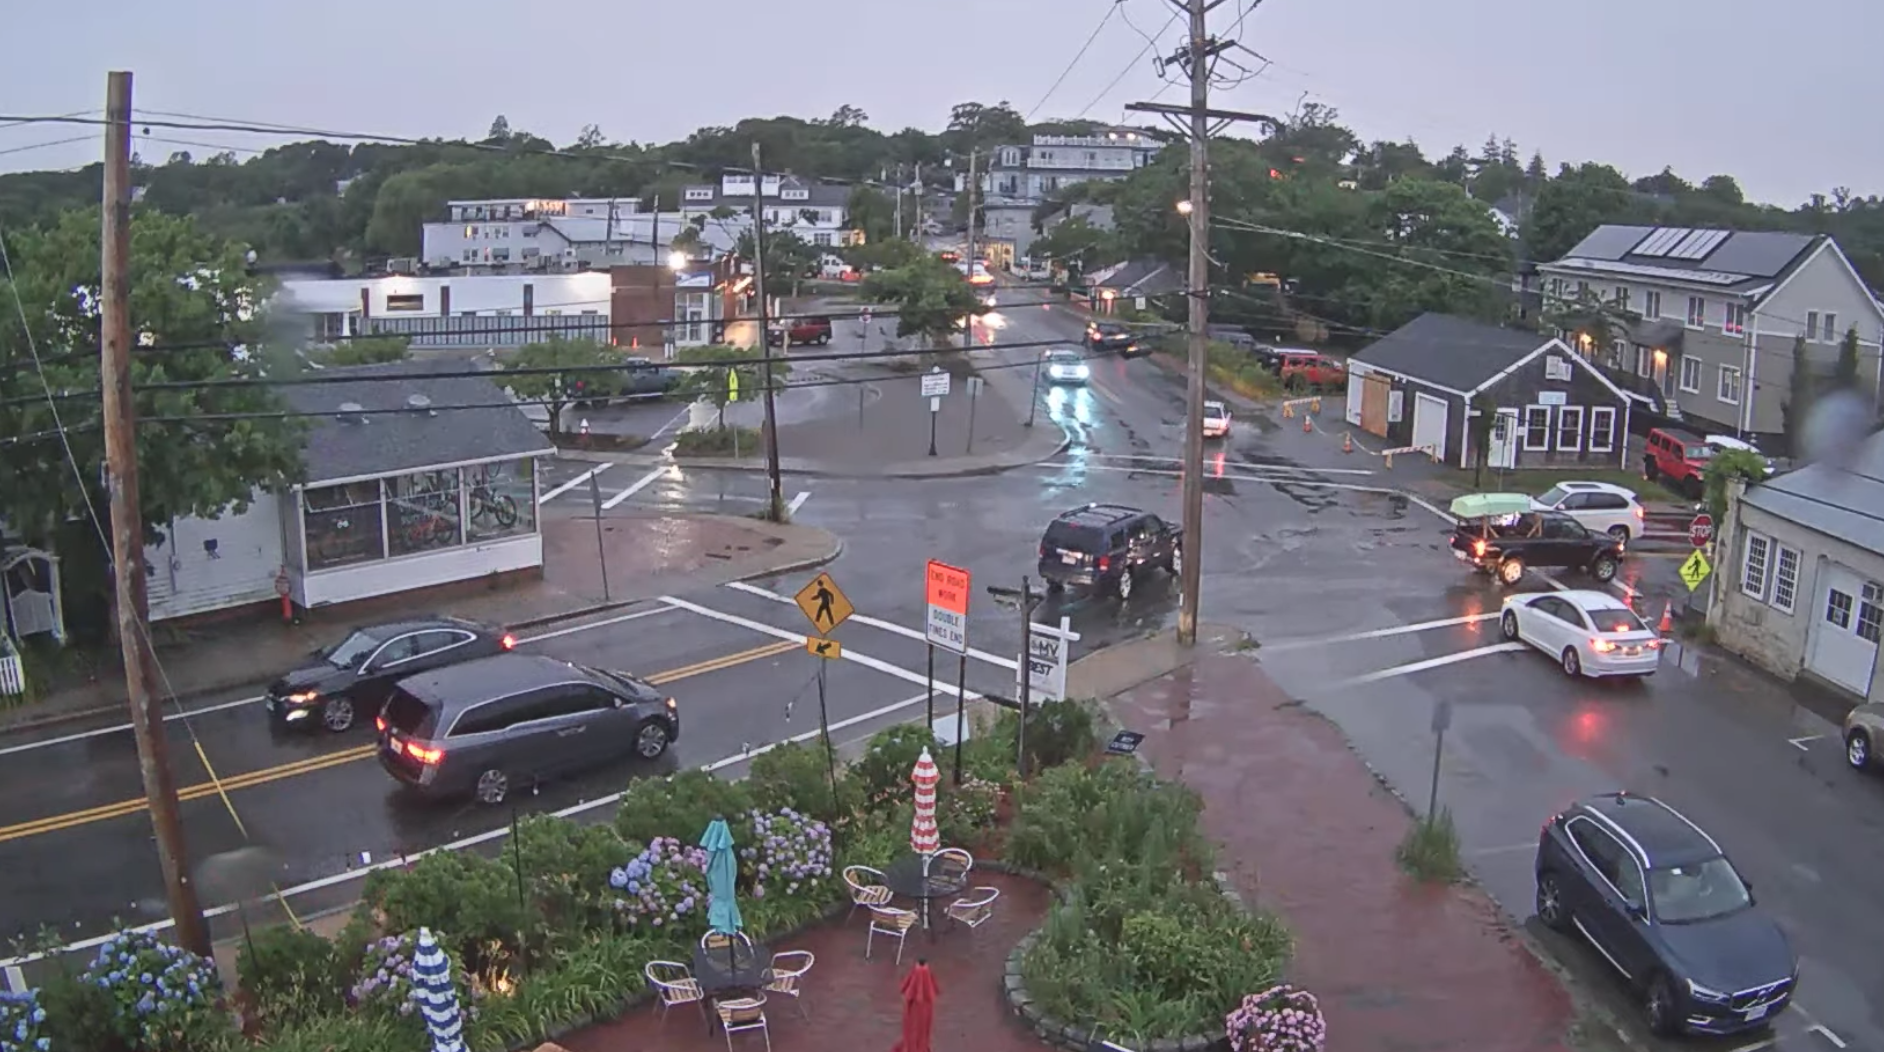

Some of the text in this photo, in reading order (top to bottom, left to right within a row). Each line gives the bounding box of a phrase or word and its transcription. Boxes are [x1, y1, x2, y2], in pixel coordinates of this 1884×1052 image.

[1690, 525, 1711, 538] STOP
[931, 569, 965, 589] END ROAD
[938, 589, 956, 602] WORK
[933, 609, 958, 627] DOUBLE
[929, 623, 963, 644] FINES END
[1029, 660, 1054, 676] BEST
